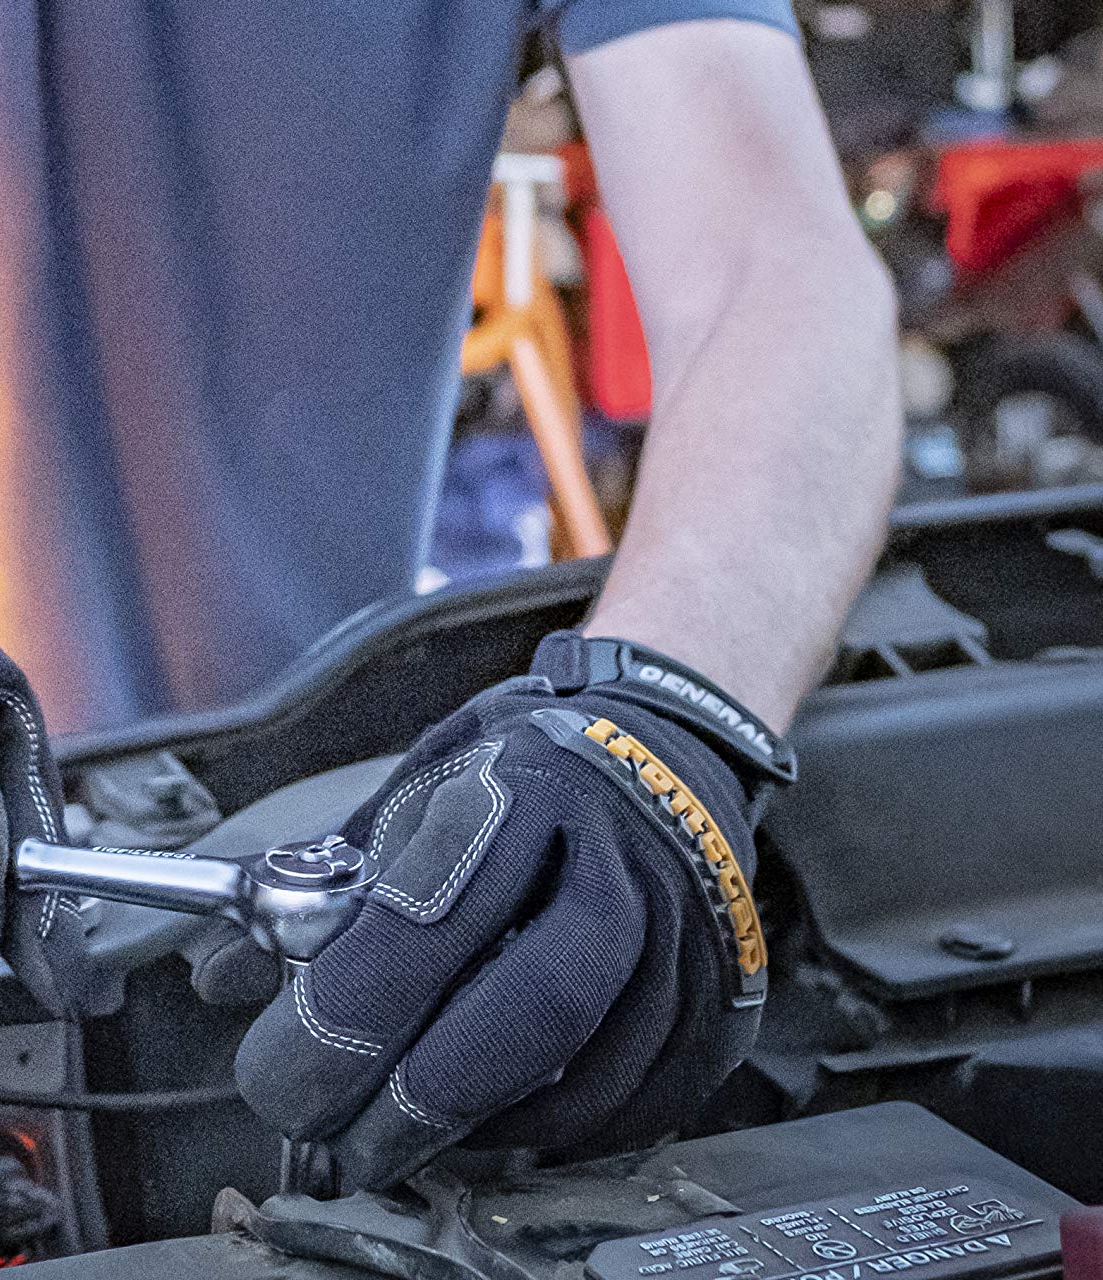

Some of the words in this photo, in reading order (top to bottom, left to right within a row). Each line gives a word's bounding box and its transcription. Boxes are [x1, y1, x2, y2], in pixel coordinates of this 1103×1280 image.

[639, 666, 775, 756] GENERAL
[882, 1206, 958, 1229] EXPLOSIVE
[866, 1239, 990, 1271] DANGER
